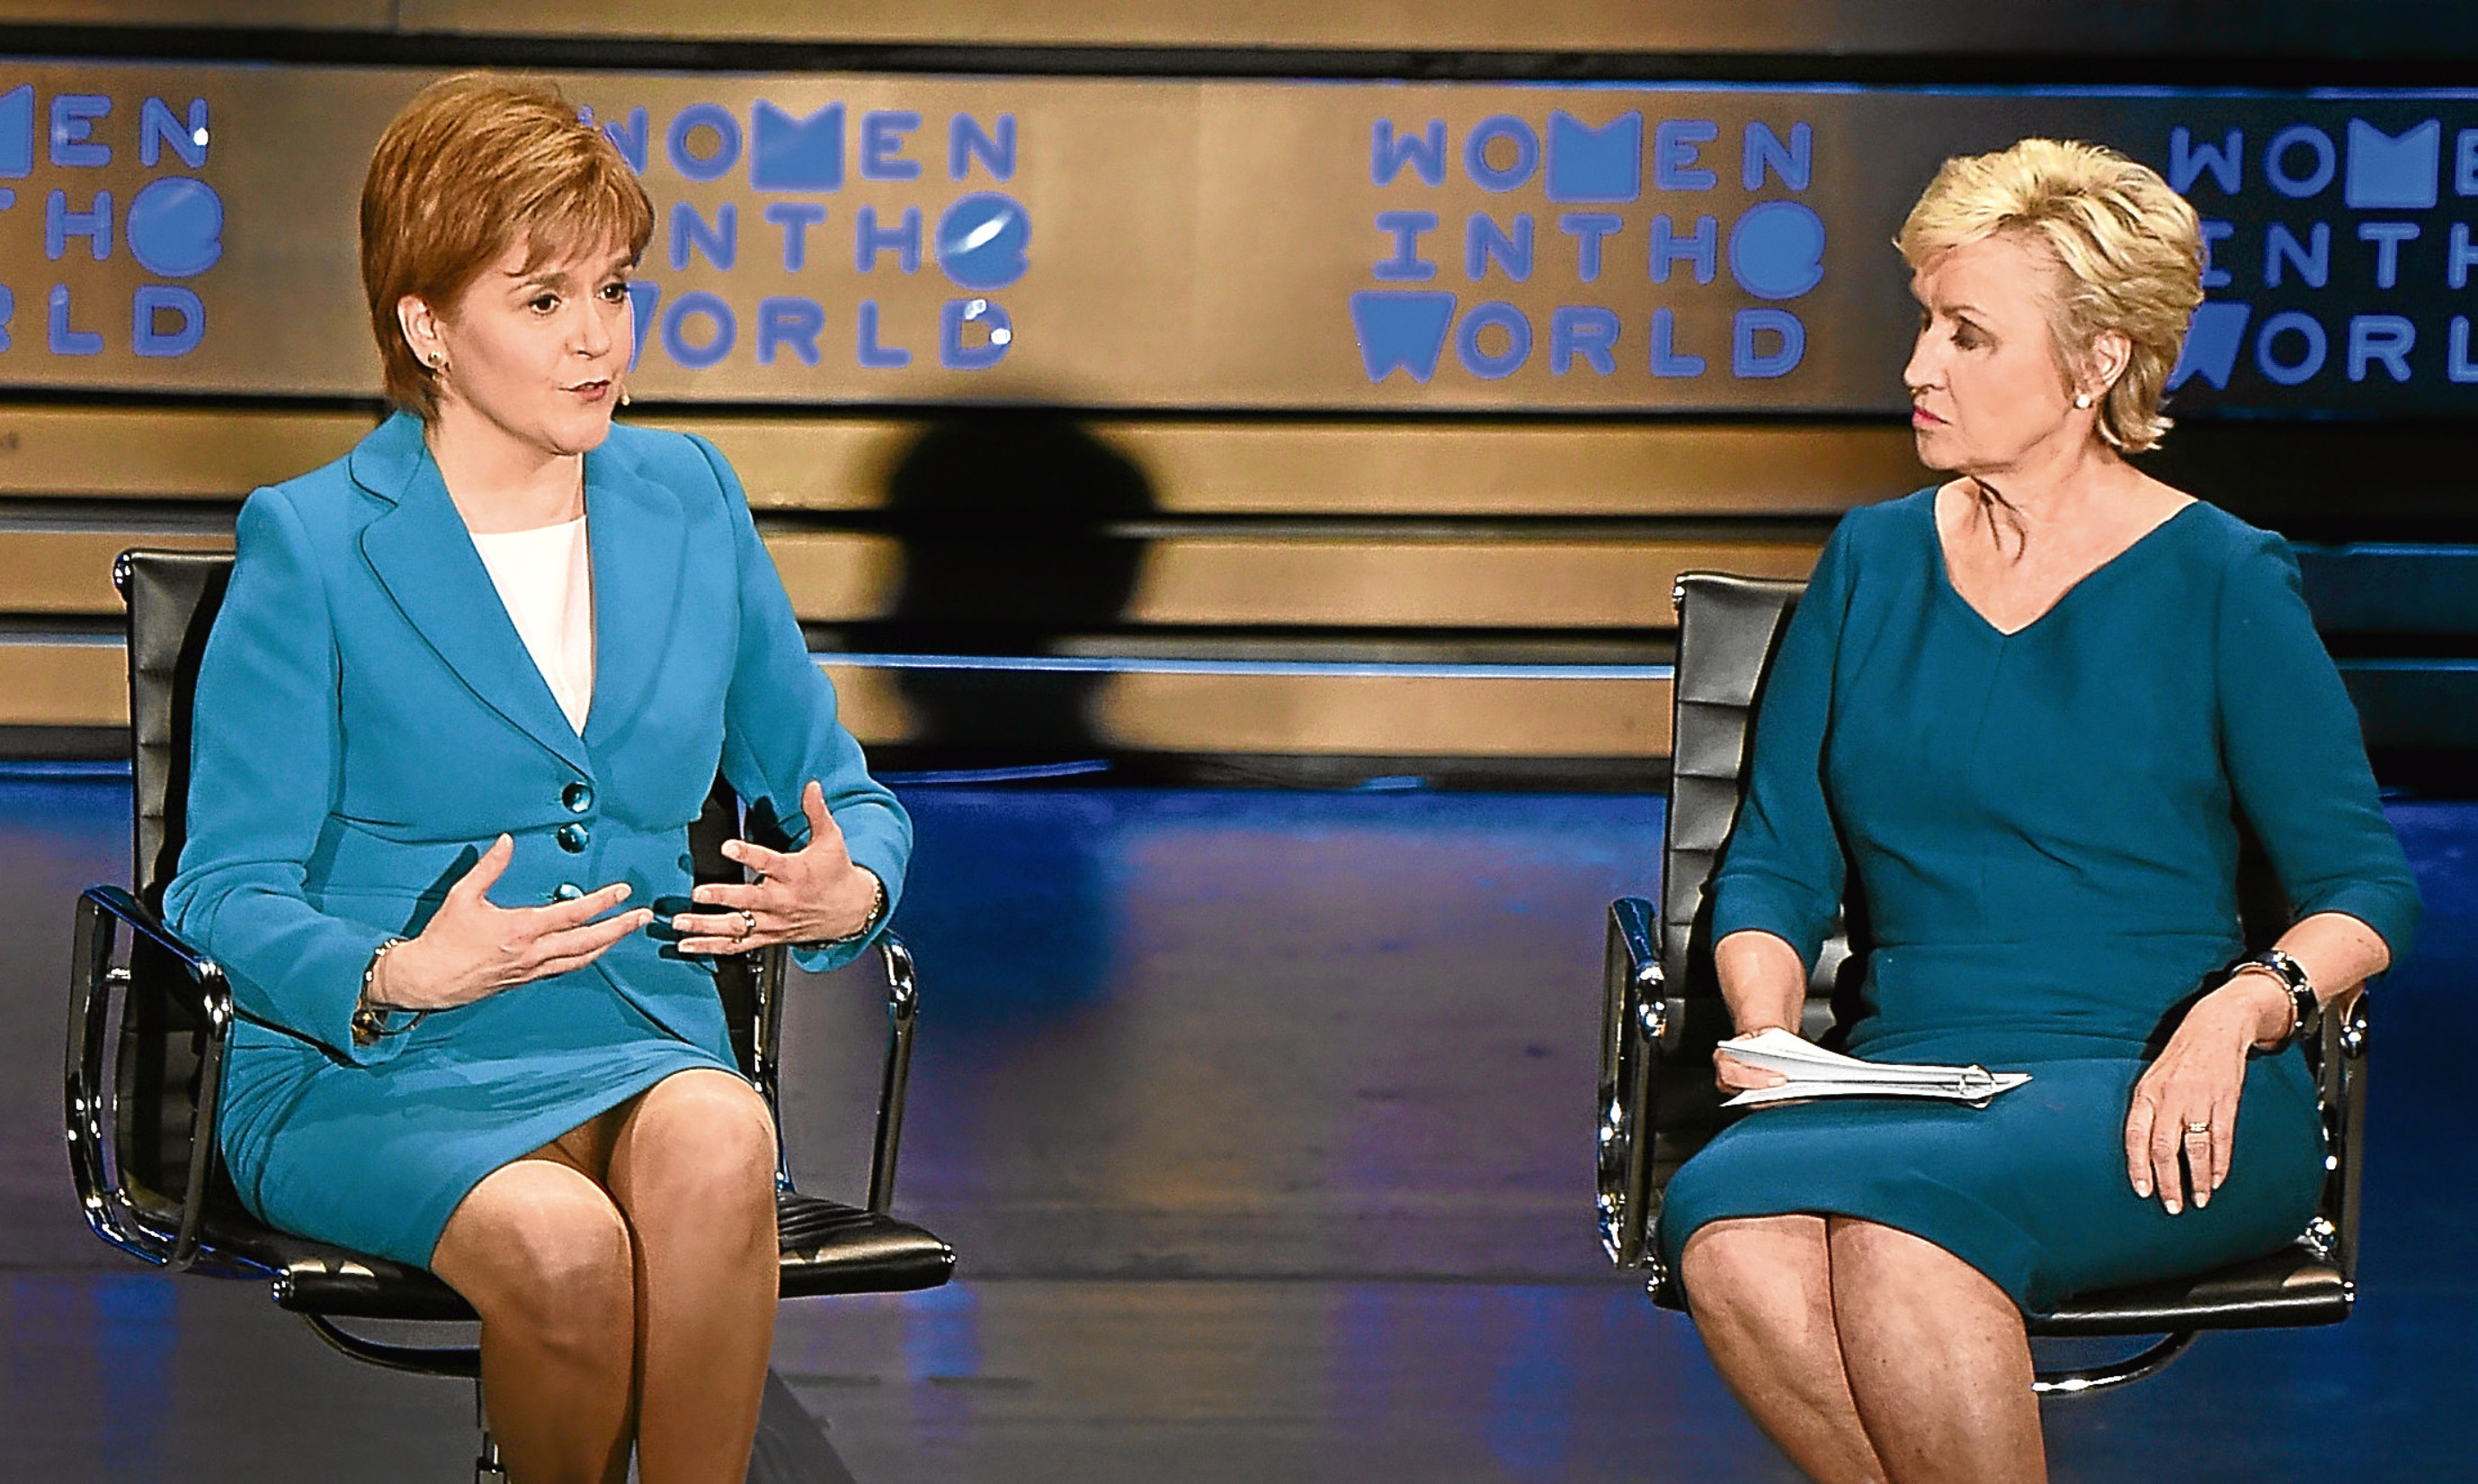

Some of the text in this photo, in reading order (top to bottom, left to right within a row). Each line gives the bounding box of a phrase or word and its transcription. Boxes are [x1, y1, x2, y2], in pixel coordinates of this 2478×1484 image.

[1371, 110, 1813, 202] WOMEN
[1373, 200, 1826, 300] IN THE
[626, 280, 1012, 369] ORLD
[1350, 290, 1806, 383] WORLD
